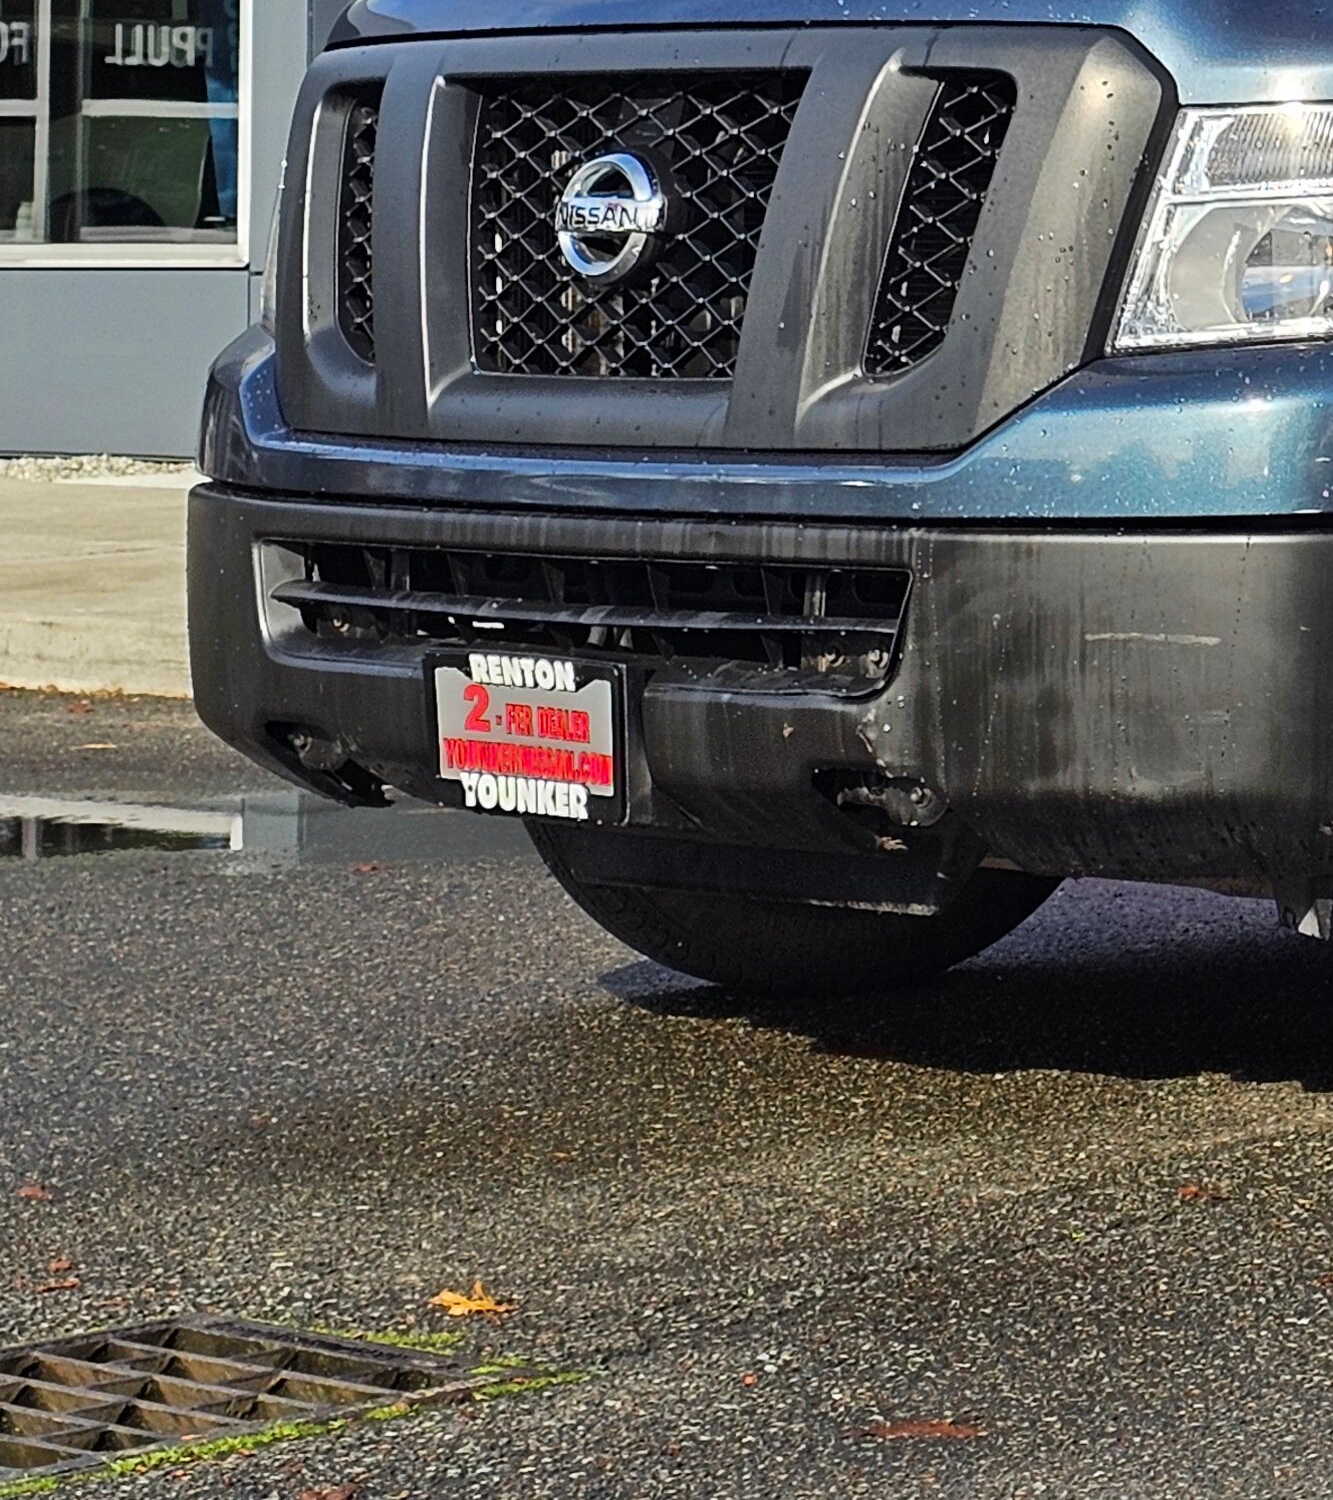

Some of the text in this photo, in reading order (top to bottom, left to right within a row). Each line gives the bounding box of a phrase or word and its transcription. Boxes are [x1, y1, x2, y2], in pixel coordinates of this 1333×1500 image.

[558, 202, 638, 227] NISSAN
[468, 653, 577, 692] RENTON
[537, 706, 591, 744] DEALER
[460, 771, 589, 820] YOUNKER
